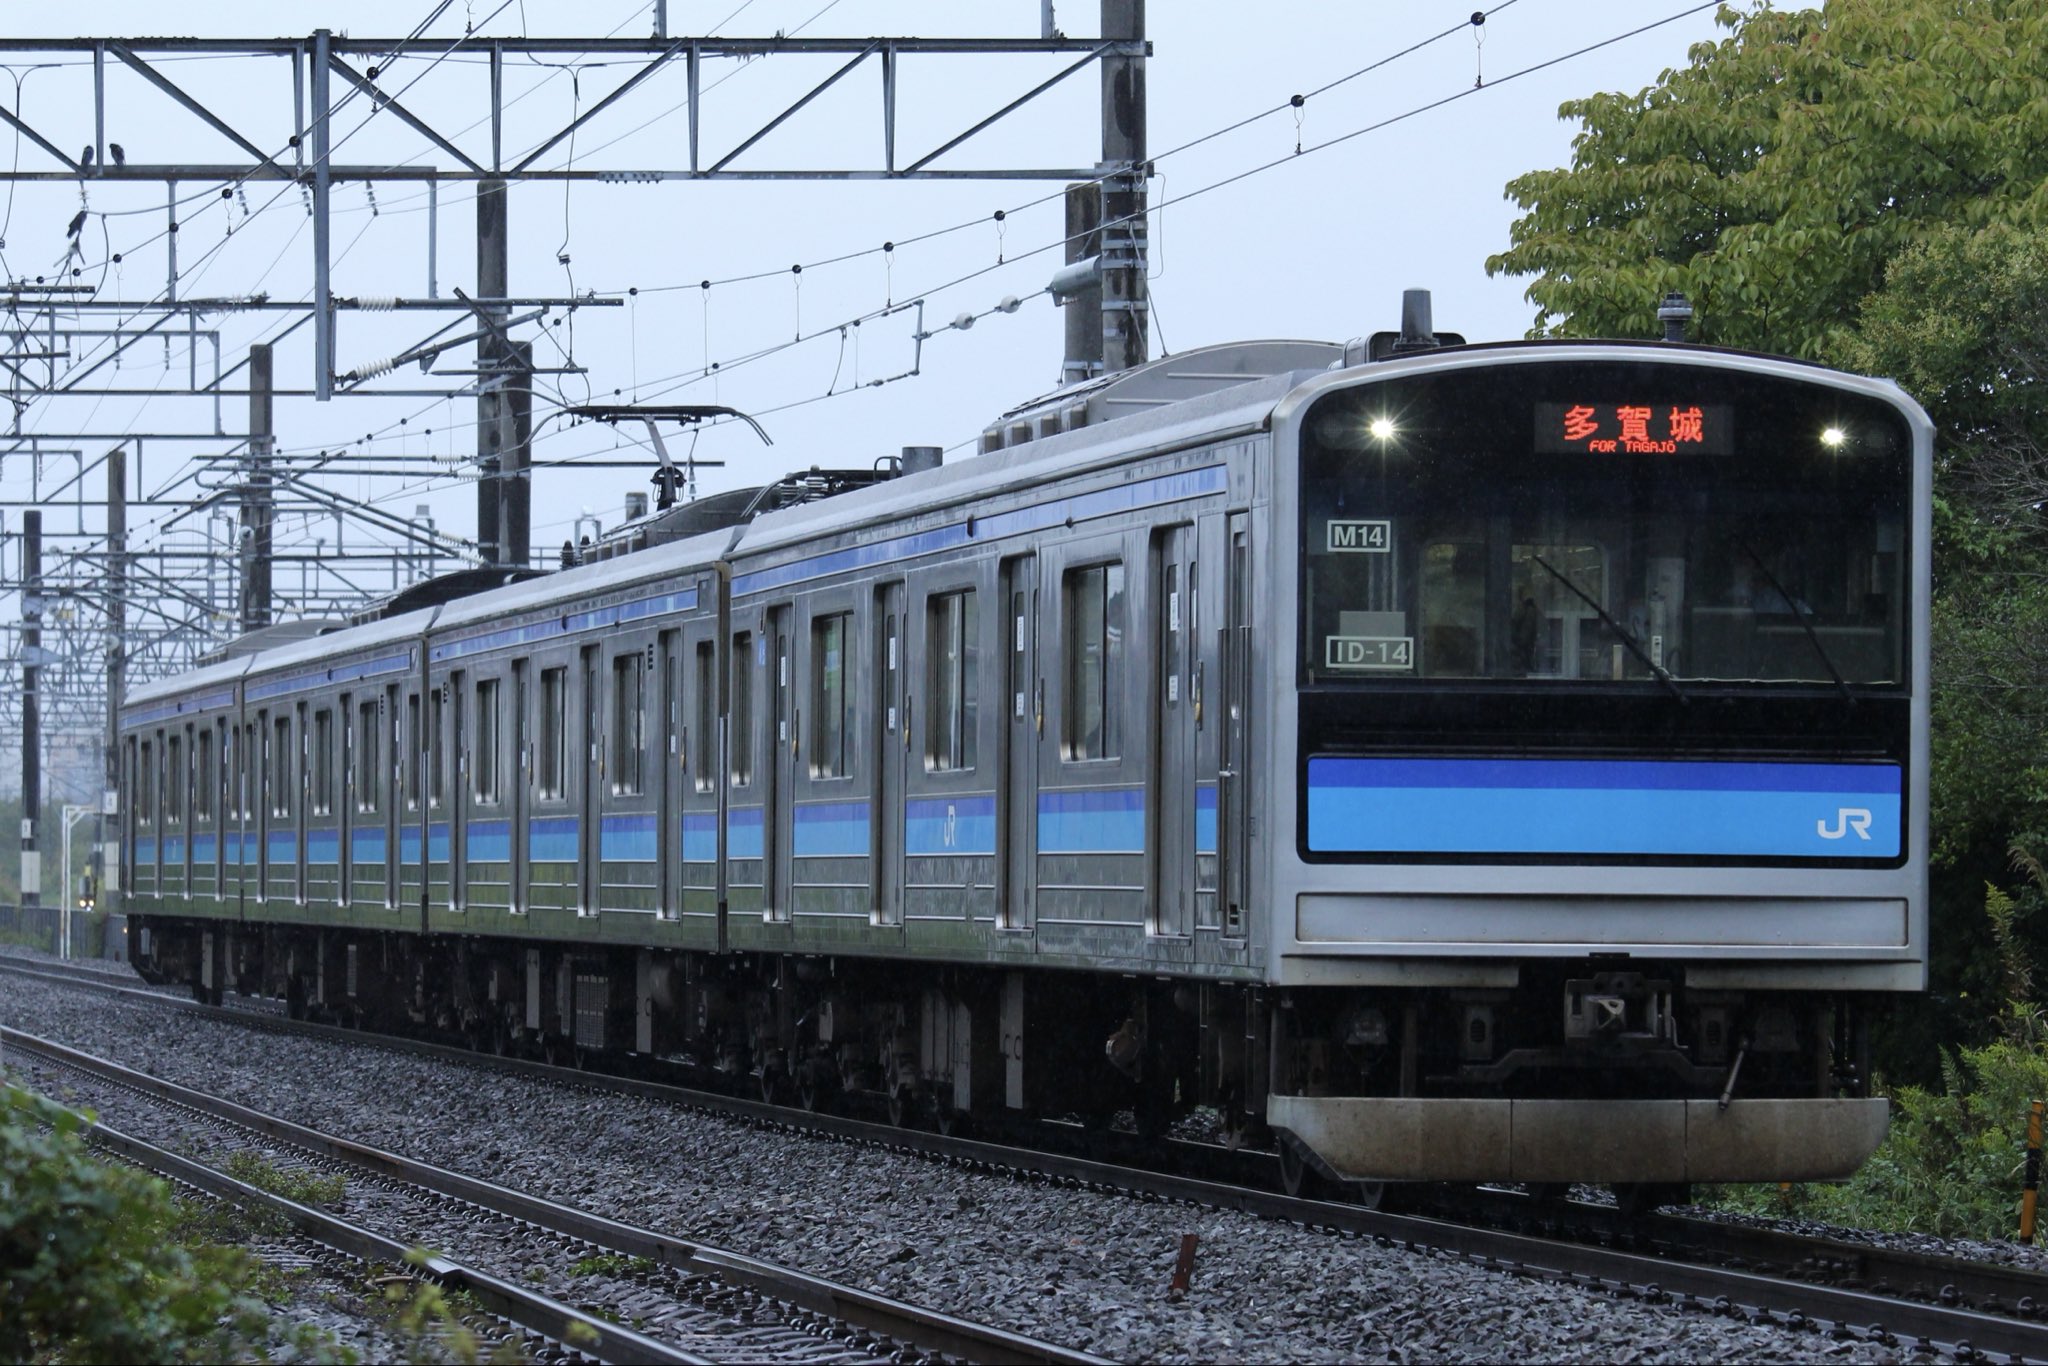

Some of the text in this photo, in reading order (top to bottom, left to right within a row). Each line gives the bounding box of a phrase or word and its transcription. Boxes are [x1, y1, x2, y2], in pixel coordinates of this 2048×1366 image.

[1564, 405, 1703, 442] 多賀城
[1589, 440, 1617, 452] FOR
[1334, 526, 1383, 547] M14
[1337, 641, 1408, 663] ID-14
[944, 804, 956, 847] JR
[1817, 808, 1872, 840] JR
